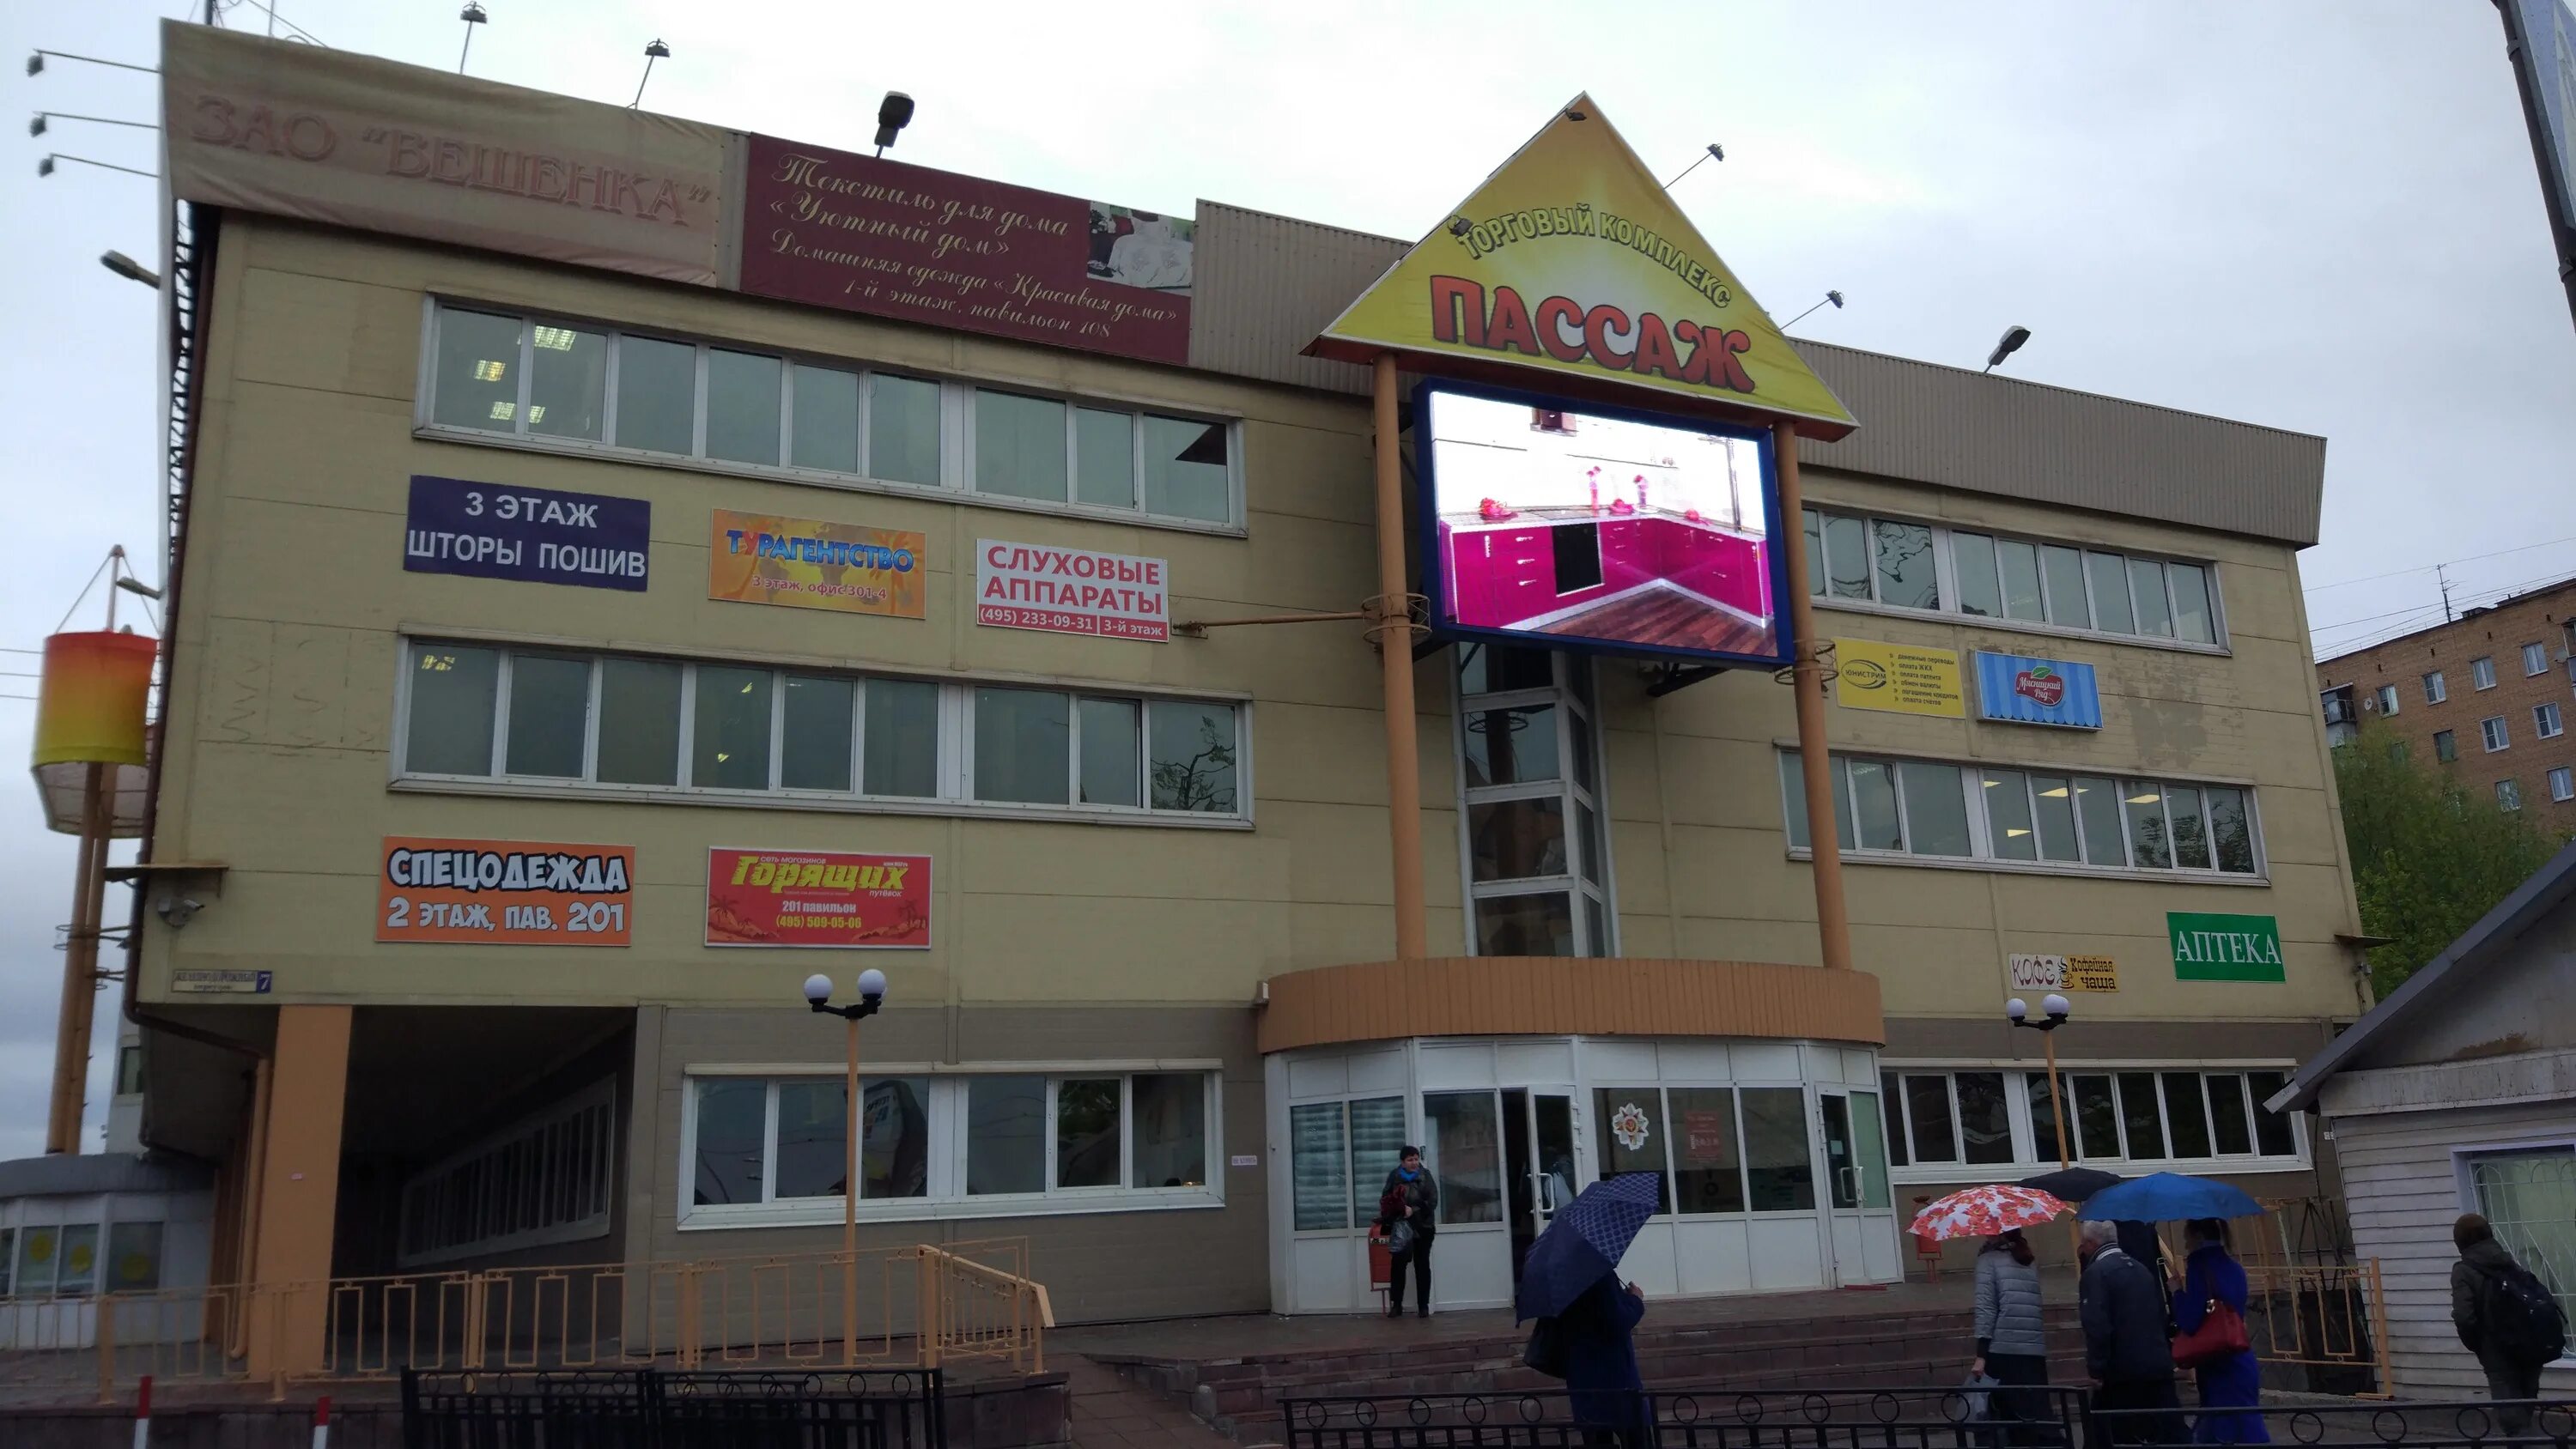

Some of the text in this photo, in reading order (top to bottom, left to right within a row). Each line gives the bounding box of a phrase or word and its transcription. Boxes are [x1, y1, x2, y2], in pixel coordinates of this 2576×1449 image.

[191, 96, 337, 162] ЗАО
[771, 153, 1070, 236] Текстиль для дома
[771, 227, 902, 274] Домашняя
[906, 264, 988, 295] одежда
[1457, 203, 1732, 309] ТОРГОВЫЙ КОМПЛЕКС
[844, 279, 878, 299] 1-й
[969, 300, 1072, 332] павильон
[1078, 320, 1112, 338] 108
[1430, 274, 1756, 394] ПАССАЖ
[465, 492, 598, 529] 3 ЭТАЖ
[408, 530, 646, 578] ШТОРЫ ПОШИВ
[726, 529, 914, 573] ТУРАГЕНТСТВО
[987, 545, 1160, 585] СЛУХОВЫЕ
[751, 575, 888, 599] 3 этаж, офис 301-4
[984, 575, 1162, 615] АППАРАТЫ
[979, 607, 1163, 636] (495) 233-09-31 3-й этаж
[1845, 670, 1886, 679] ЮНИСТРИМ
[2016, 676, 2062, 691] Мясницкий
[2034, 688, 2049, 701] Ряд
[388, 847, 631, 894] СПЕЦОДЕЖДА
[731, 855, 909, 894] Горящих
[387, 896, 625, 933] 2 ЭТАЖ, ПАВ. 201
[776, 914, 805, 928] (495)
[782, 900, 857, 913] 201 павильон
[2069, 957, 2114, 974] Кофейная
[2174, 930, 2283, 965] АПТЕКА
[260, 976, 270, 991] 7
